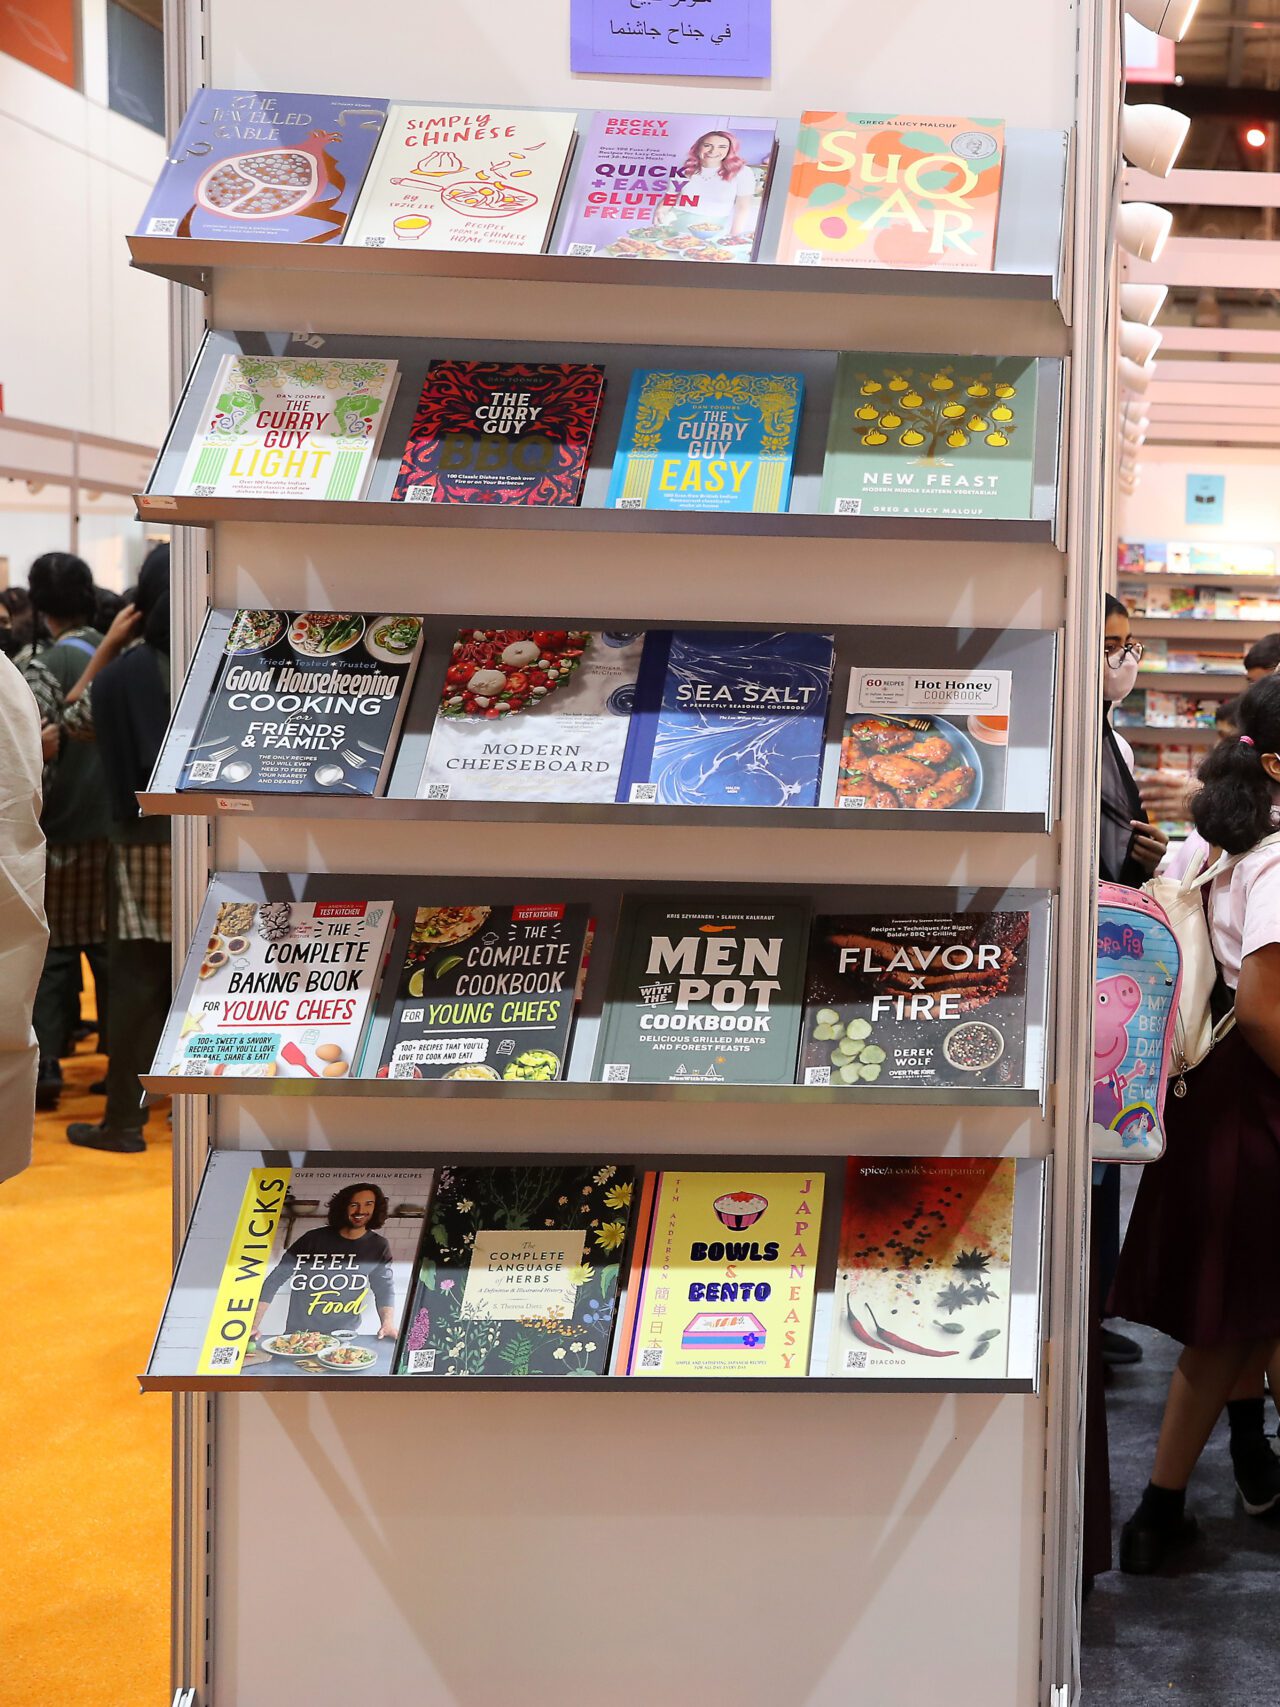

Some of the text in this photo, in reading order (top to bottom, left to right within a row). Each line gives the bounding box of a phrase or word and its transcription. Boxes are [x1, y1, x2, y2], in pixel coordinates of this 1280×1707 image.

[610, 20, 732, 45] في جناح جاشنما
[407, 114, 491, 130] SIMPLY
[608, 118, 668, 128] BECKY
[405, 125, 516, 147] CHINESE
[605, 127, 669, 137] EXCELL
[595, 163, 687, 178] QUICK
[588, 191, 700, 207] GLUTEN
[584, 206, 650, 220] FREE
[286, 400, 311, 412] THE
[491, 392, 531, 406] THE
[475, 405, 542, 420] CURRY
[704, 411, 727, 422] THE
[256, 411, 331, 431] CURRY
[483, 420, 526, 434] GUY
[678, 422, 748, 441] CURRY
[264, 431, 310, 449] GUY
[438, 433, 553, 473] BBQ
[688, 440, 732, 460] GUY
[230, 448, 331, 479] LIGHT
[659, 459, 753, 492] EASY
[863, 472, 999, 488] NEW FEAST
[225, 666, 400, 700] Good Housekeeping
[866, 679, 882, 687] 60
[914, 681, 992, 692] Hot Honey
[676, 684, 816, 703] SEA SALT
[924, 691, 981, 700] COOKBOOK
[228, 693, 382, 715] COOKING
[248, 722, 345, 737] FRIENDS
[241, 735, 346, 750] & FAMILY
[482, 743, 581, 756] MODERN
[446, 758, 610, 772] CHEESEBOARD
[328, 924, 350, 936] THE
[524, 926, 547, 938] THE
[1123, 928, 1143, 957] Pig
[265, 941, 370, 964] COMPLETE
[467, 944, 570, 967] COMPLETE
[646, 936, 783, 976] MEN
[839, 945, 1001, 974] FLAVOR
[228, 969, 363, 993] BAKING BOOK
[456, 971, 566, 996] COOKBOOK
[644, 994, 667, 1003] THE
[675, 979, 781, 1012] POT
[203, 999, 356, 1021] FOR YOUNG CHEFS
[871, 994, 962, 1022] FIRE
[1148, 997, 1167, 1011] MY
[404, 1001, 561, 1025] FOR YOUNG CHEFS
[639, 1014, 771, 1031] COOKBOOK
[189, 1045, 215, 1053] RECIPES
[236, 1045, 257, 1053] YOU'LL
[894, 1049, 934, 1057] DEREK
[1136, 1038, 1161, 1057] DAY
[896, 1058, 932, 1067] WOLF
[235, 1178, 285, 1282] WICKS
[490, 1252, 565, 1260] COMPLETE
[690, 1242, 779, 1261] BOWLS
[293, 1254, 360, 1270] FEEL
[488, 1264, 562, 1272] LANGUAGE
[495, 1275, 550, 1285] of HERBS
[725, 1265, 737, 1279] &
[290, 1274, 368, 1291] GOOD
[689, 1283, 771, 1302] BENTO
[307, 1289, 369, 1315] Food
